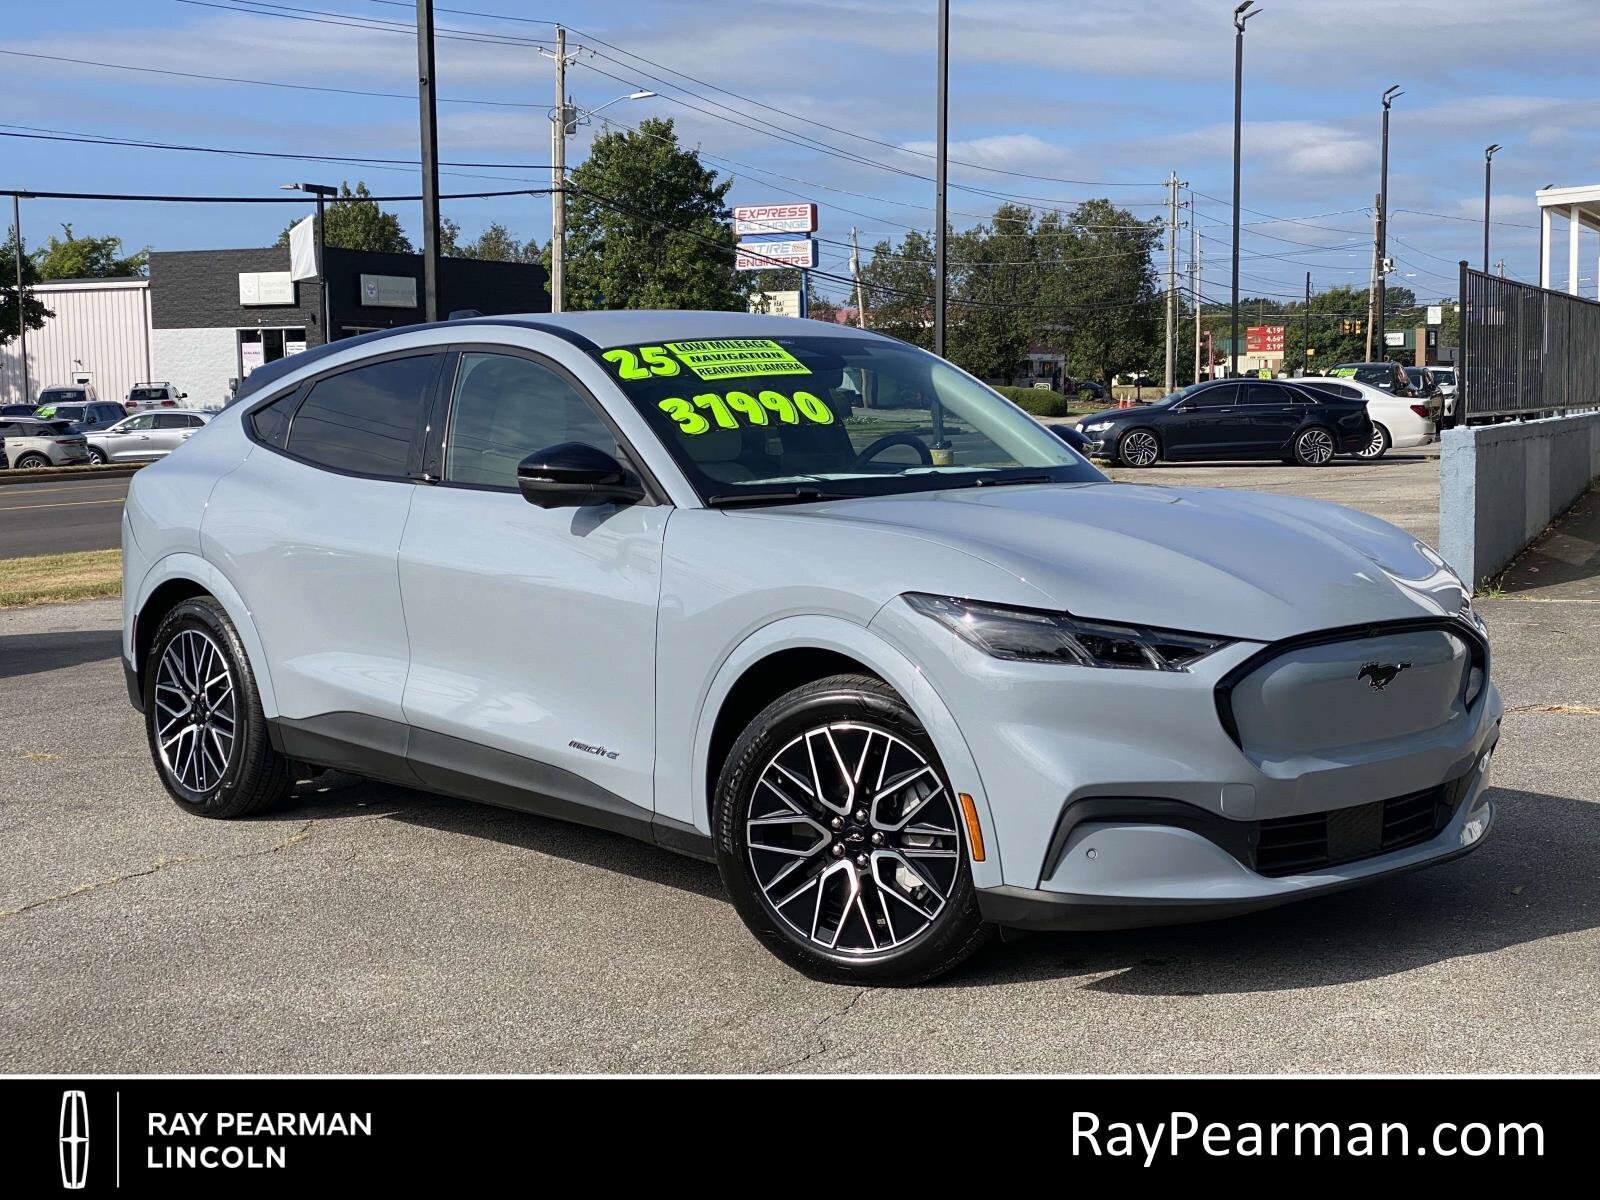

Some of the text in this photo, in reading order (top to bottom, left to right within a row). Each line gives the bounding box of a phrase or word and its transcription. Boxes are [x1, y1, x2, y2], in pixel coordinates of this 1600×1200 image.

[738, 206, 809, 220] EXPRESS
[737, 220, 809, 232] OIL CHANGE
[757, 243, 791, 254] TIRE
[738, 256, 810, 268] ENGINEERS
[674, 340, 773, 352] LOW MILEAGE
[602, 346, 681, 380] 25
[689, 351, 784, 363] NAVIGATION
[697, 361, 803, 376] REARVIEW CAMERA
[658, 390, 834, 435] 37990
